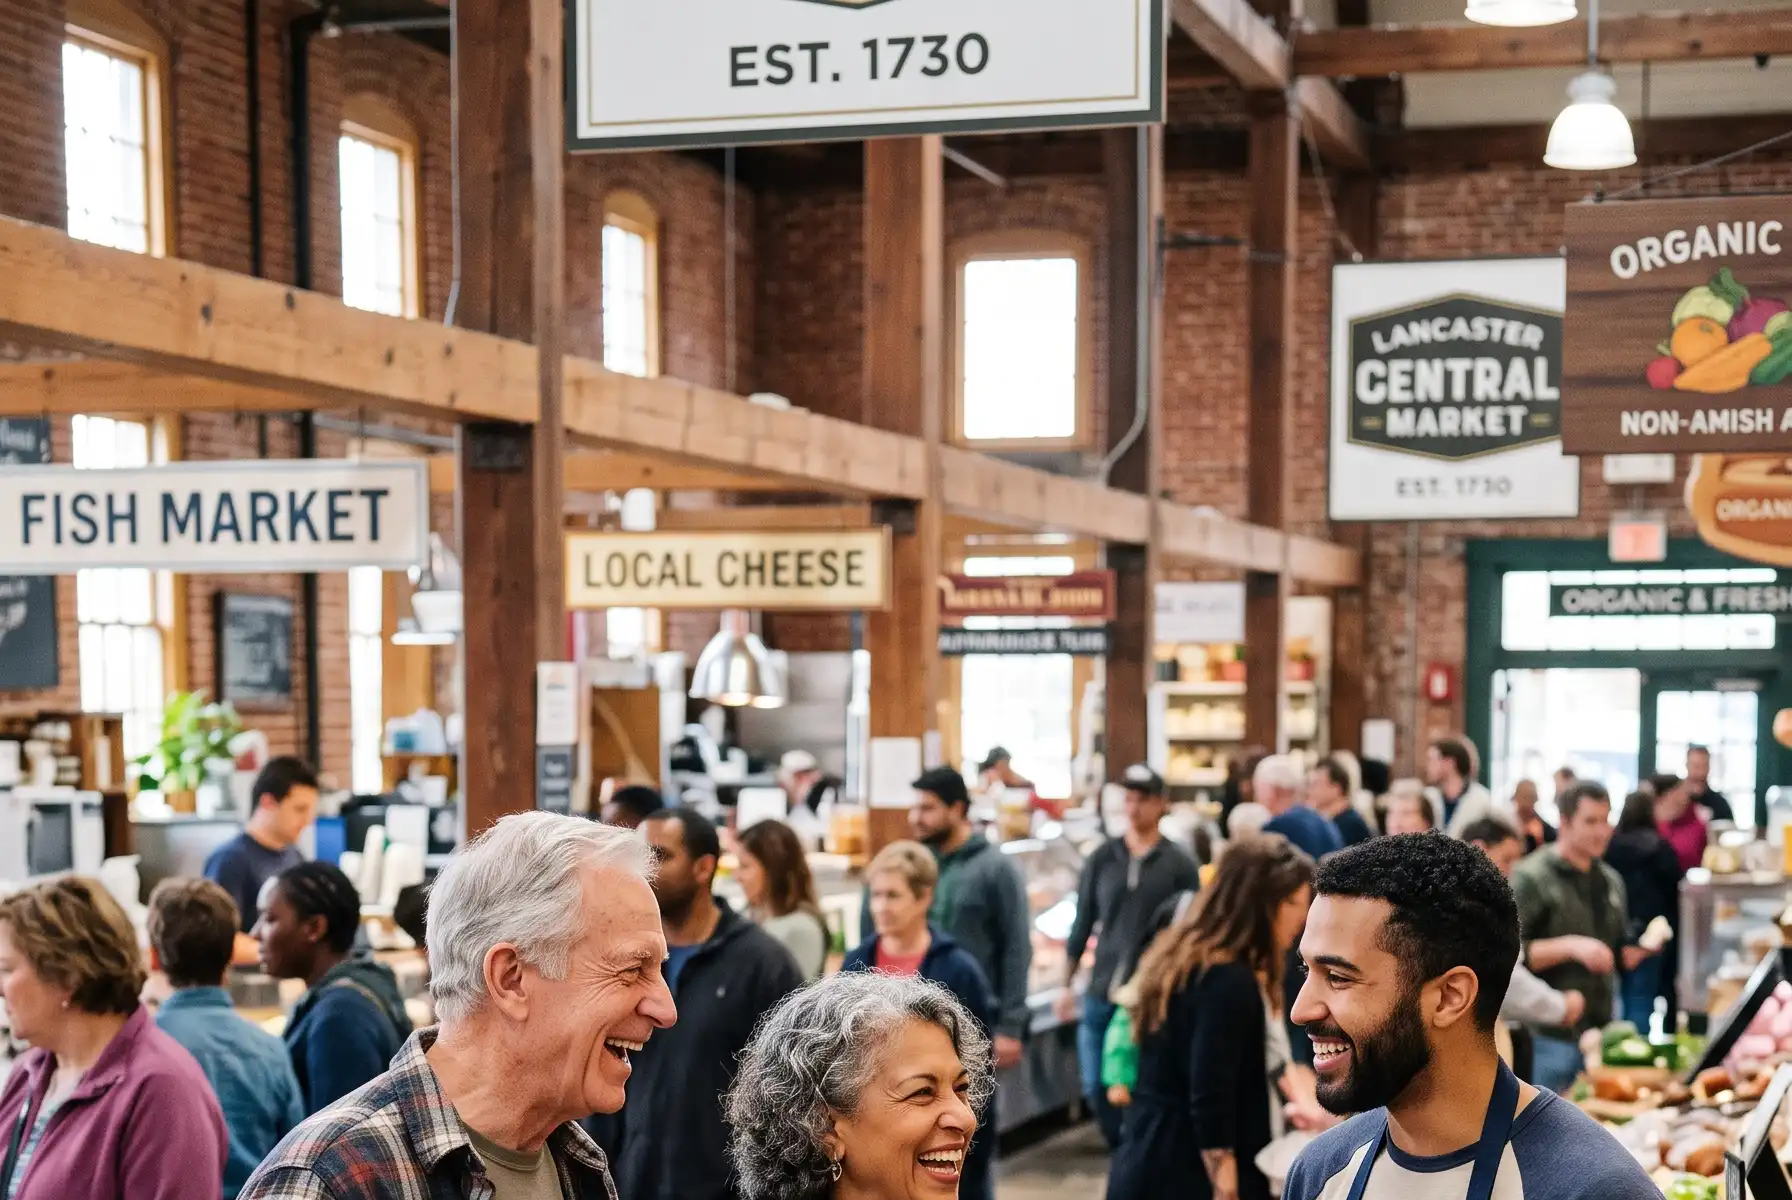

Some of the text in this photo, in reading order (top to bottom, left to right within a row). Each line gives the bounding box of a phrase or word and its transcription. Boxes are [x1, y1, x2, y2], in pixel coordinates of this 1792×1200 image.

[729, 32, 989, 87] EST. 1730
[1610, 220, 1784, 279] ORGANIC
[1371, 315, 1545, 354] LANCASTER
[1356, 355, 1561, 404] CENTRAL
[1386, 404, 1529, 437] MARKET
[1620, 407, 1774, 436] NON-AMISH
[21, 488, 390, 546] FISH MARKET
[584, 548, 865, 588] LOCAL CHEESE
[1562, 588, 1684, 613] ORGANIC
[1687, 587, 1708, 613] &
